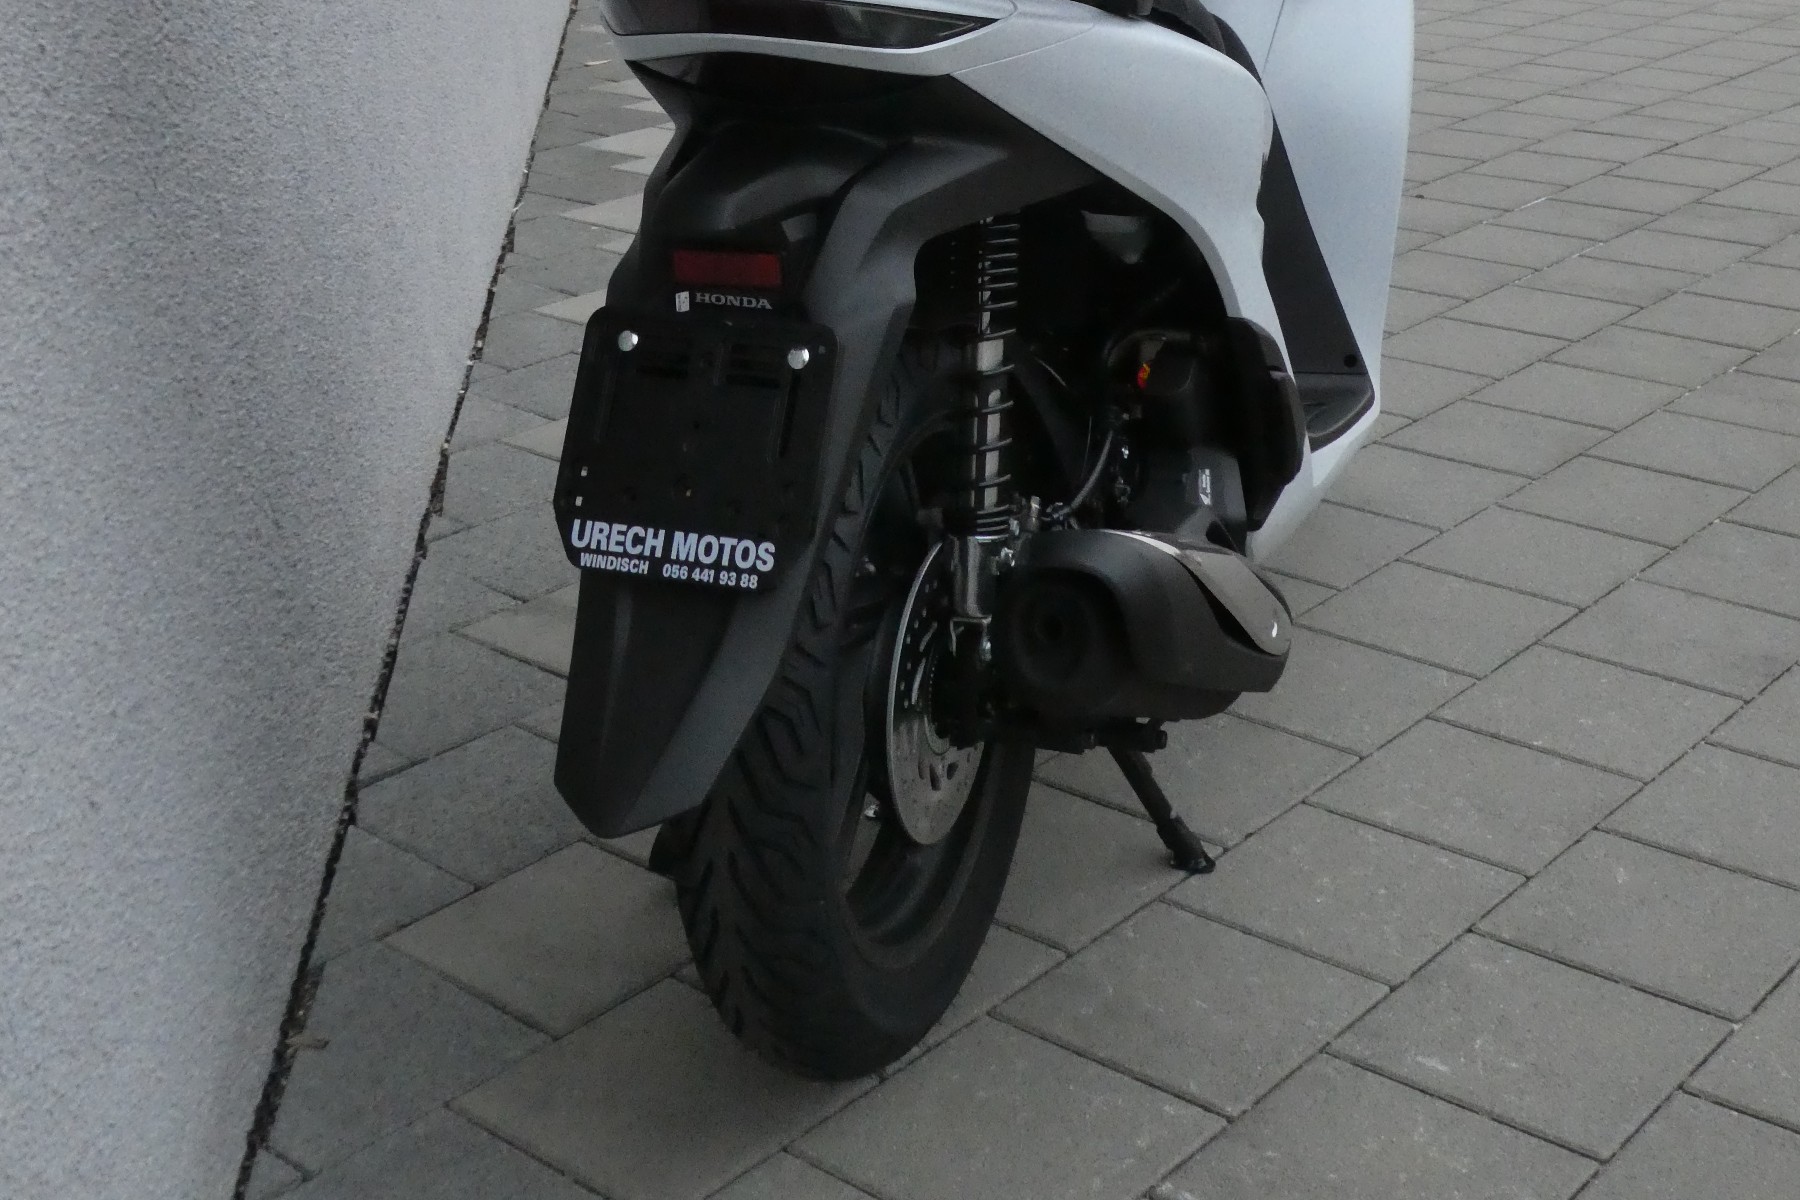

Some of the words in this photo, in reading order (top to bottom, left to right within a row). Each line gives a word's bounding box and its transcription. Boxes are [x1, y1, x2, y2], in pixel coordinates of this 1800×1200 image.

[695, 292, 773, 310] HONDA
[571, 518, 666, 558] URECH
[670, 530, 776, 572] MOTOS
[580, 552, 649, 575] WINDISCH
[662, 563, 689, 580] 056
[691, 568, 715, 584] 441
[719, 570, 737, 586] 93
[739, 573, 759, 589] 88
